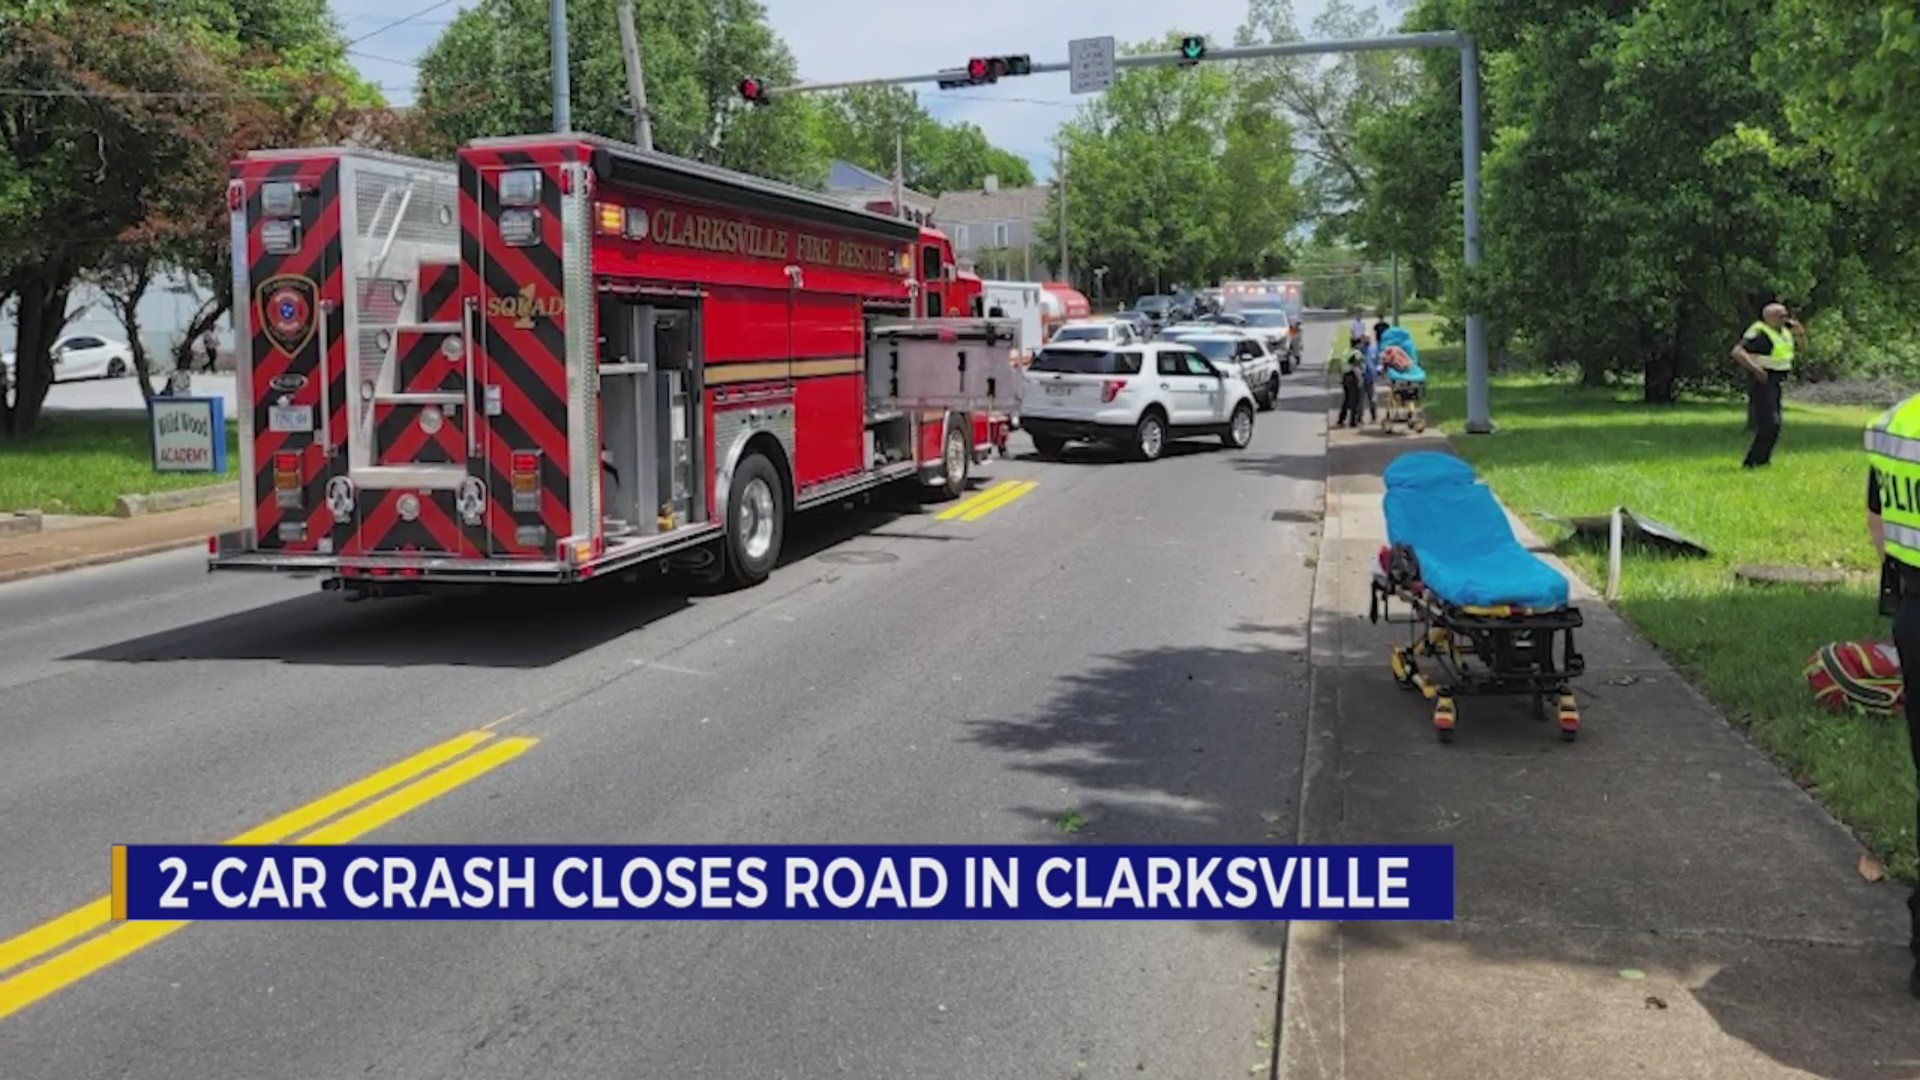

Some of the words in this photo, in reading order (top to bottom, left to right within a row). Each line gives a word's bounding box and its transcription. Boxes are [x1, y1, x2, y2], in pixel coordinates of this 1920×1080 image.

[651, 208, 788, 258] CLARKSVILLE
[796, 233, 832, 264] FIRE
[838, 241, 887, 271] RESCUE
[487, 296, 564, 317] SQUAD
[161, 447, 208, 463] ACADEMY
